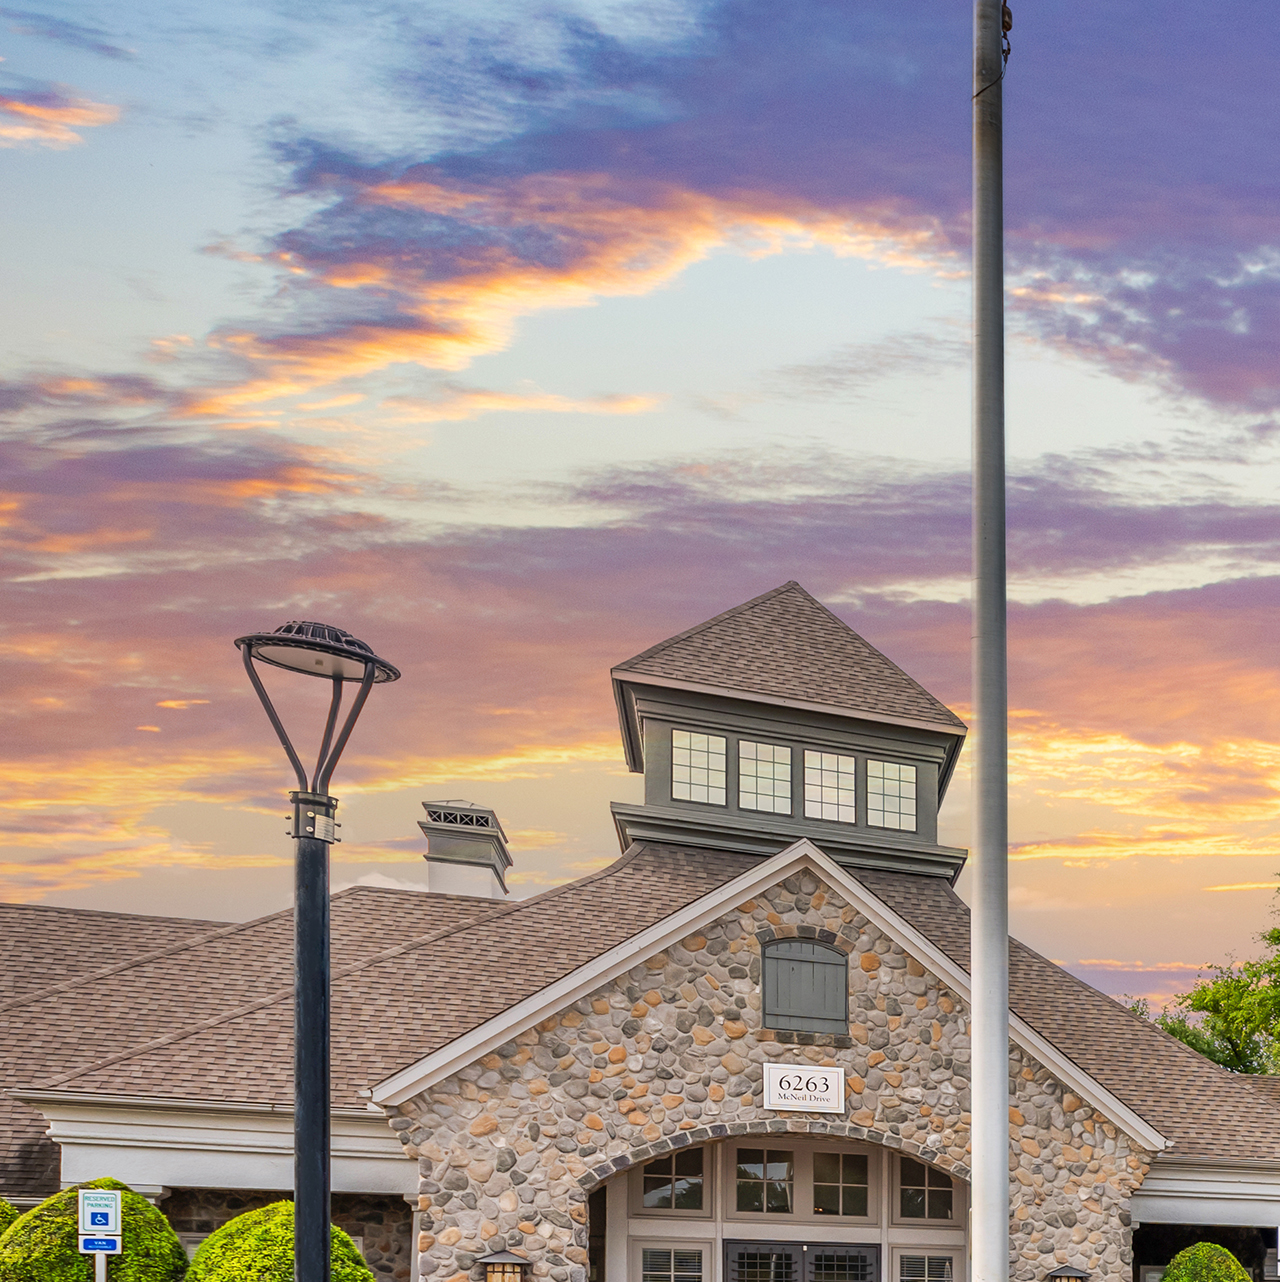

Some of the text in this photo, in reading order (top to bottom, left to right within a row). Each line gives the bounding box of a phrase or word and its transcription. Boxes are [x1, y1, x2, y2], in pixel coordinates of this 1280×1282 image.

[779, 1074, 829, 1093] 6263
[778, 1093, 830, 1102] McNeil Drive
